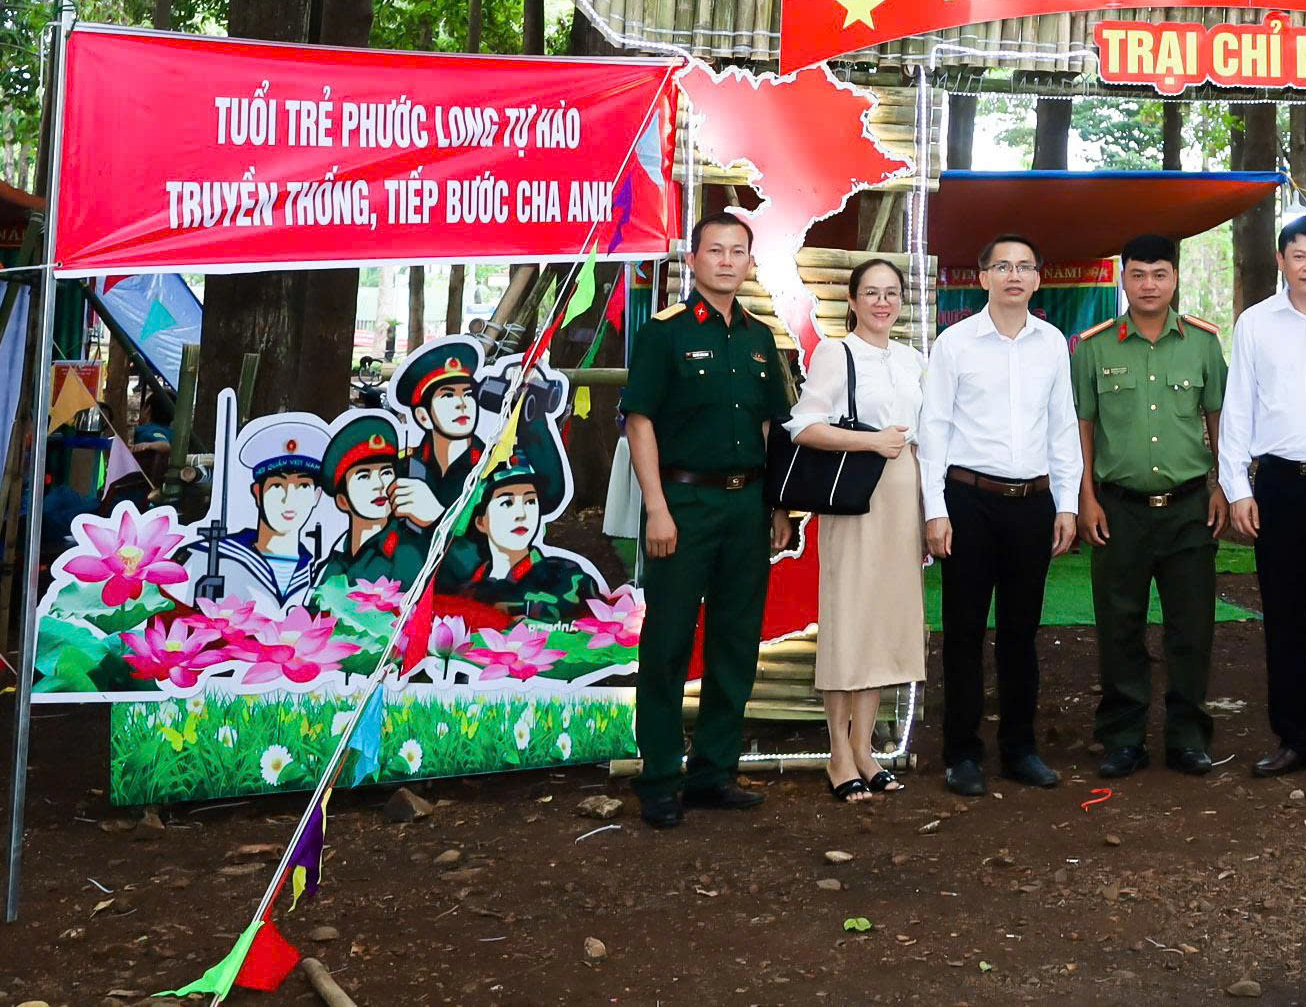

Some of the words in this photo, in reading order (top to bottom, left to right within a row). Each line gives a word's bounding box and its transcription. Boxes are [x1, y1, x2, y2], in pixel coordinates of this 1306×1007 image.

[1102, 28, 1198, 82] TRẠI
[1213, 16, 1283, 78] CHỈ
[215, 79, 277, 146] TUỔI
[286, 85, 333, 147] TRẺ
[342, 93, 428, 149] PHƯỚC
[436, 106, 500, 148] LONG
[503, 104, 537, 157] TỰ
[536, 99, 581, 149] HÀO
[165, 166, 276, 230] TRUYỀN
[284, 165, 378, 231] THỐNG,
[384, 164, 439, 225] TIẾP
[446, 171, 509, 223] BƯỚC
[516, 180, 561, 222] CHA
[567, 181, 613, 222] ANH
